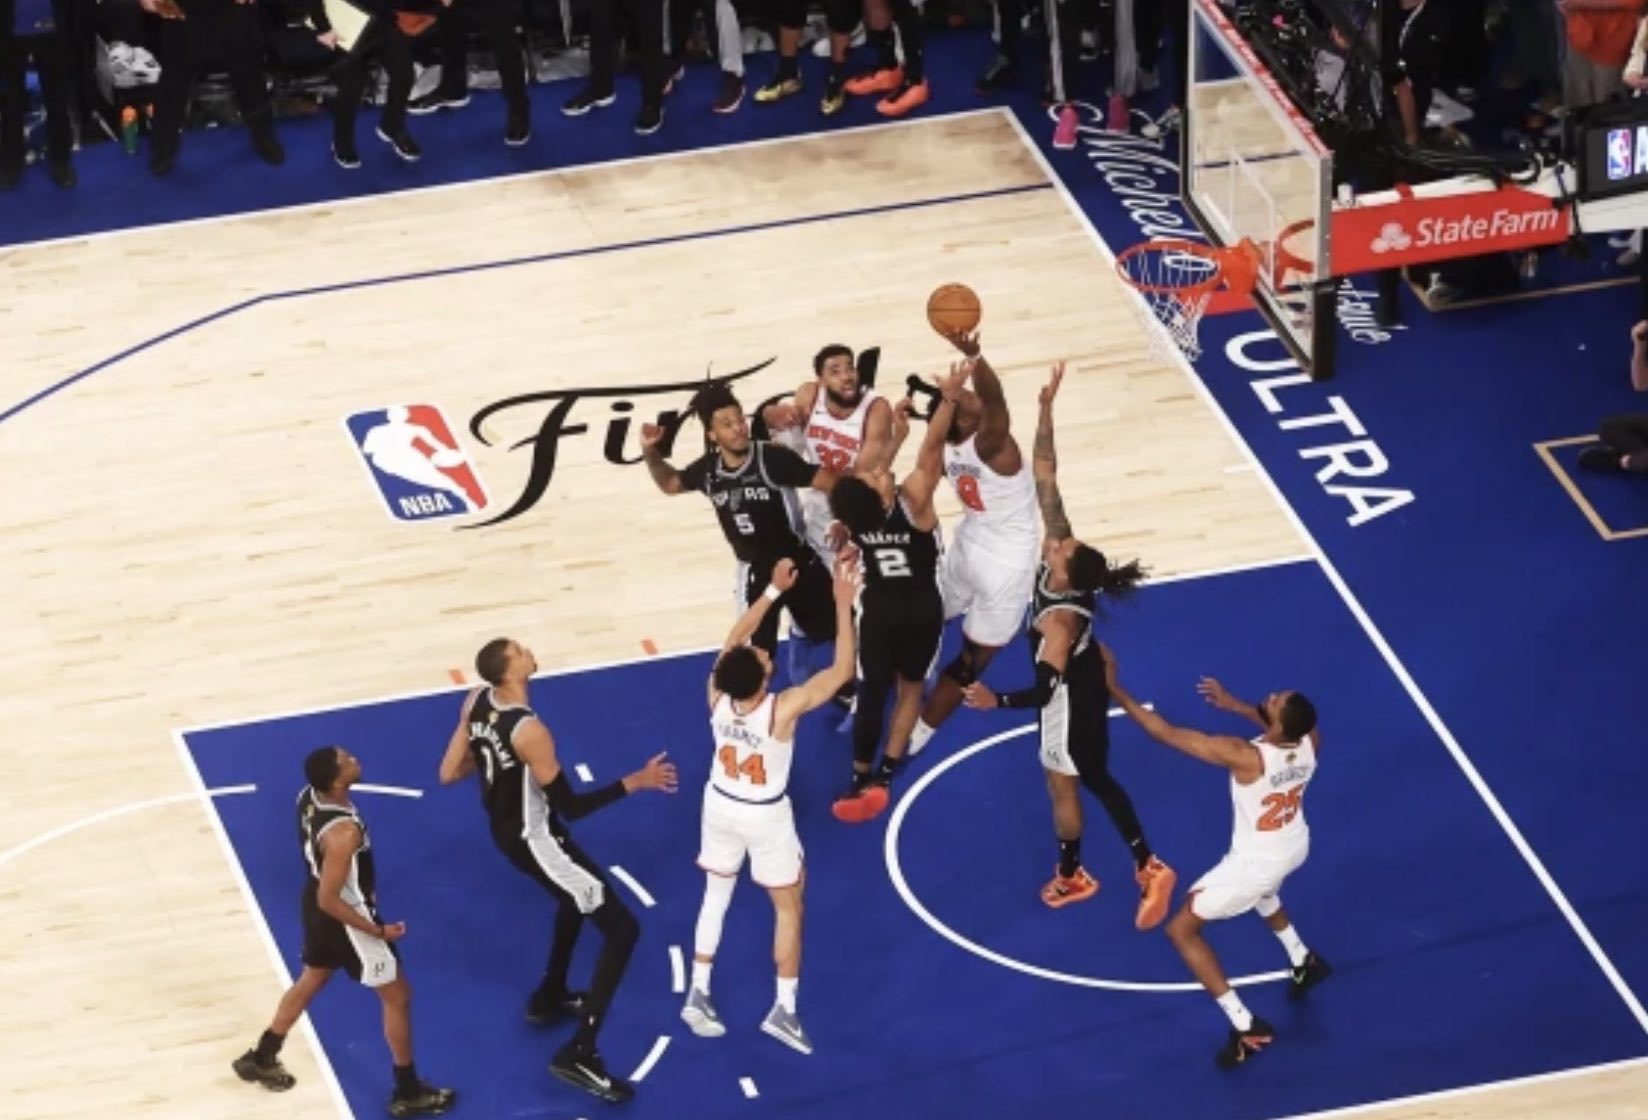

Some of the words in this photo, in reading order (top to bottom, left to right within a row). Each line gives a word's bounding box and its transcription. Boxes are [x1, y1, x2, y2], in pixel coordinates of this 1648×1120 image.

[1225, 329, 1415, 527] ULTRA
[399, 492, 453, 517] NBA
[733, 512, 755, 535] 5
[874, 548, 912, 577] 2
[719, 745, 766, 785] 44
[1256, 782, 1304, 831] 25
